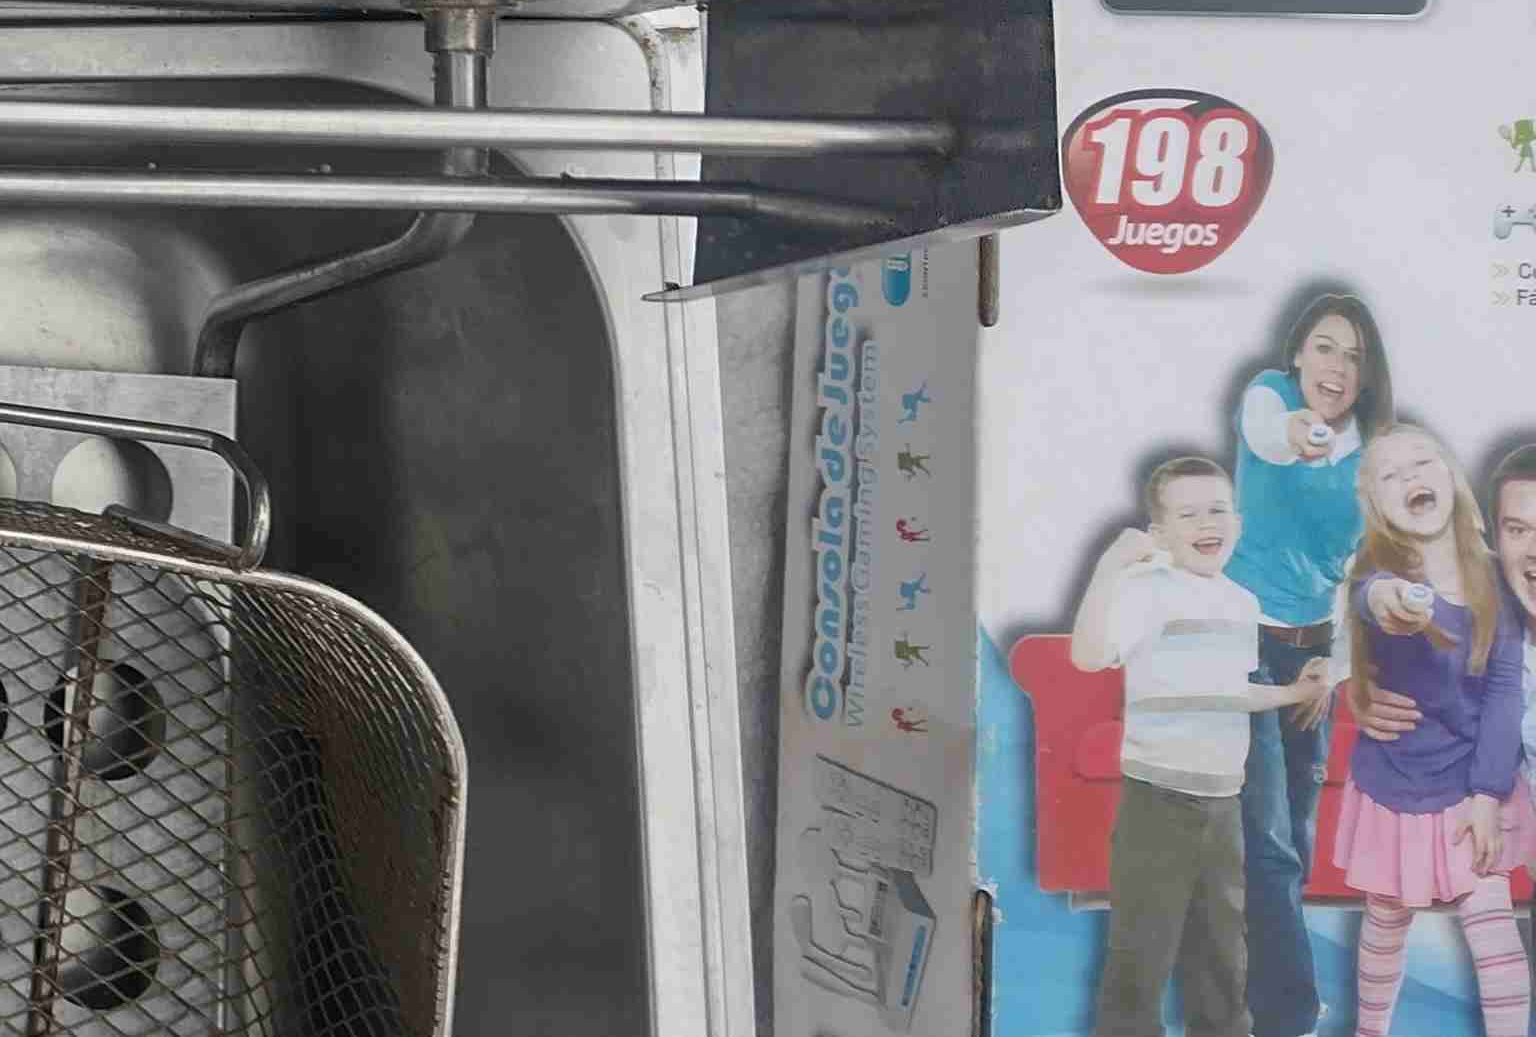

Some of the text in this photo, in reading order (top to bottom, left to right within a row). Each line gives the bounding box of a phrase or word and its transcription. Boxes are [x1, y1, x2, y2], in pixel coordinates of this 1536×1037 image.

[1089, 116, 1249, 207] 198
[1108, 216, 1219, 254] Juegos
[819, 416, 847, 483] de
[853, 464, 879, 593] Gaming
[811, 494, 843, 720] Consola
